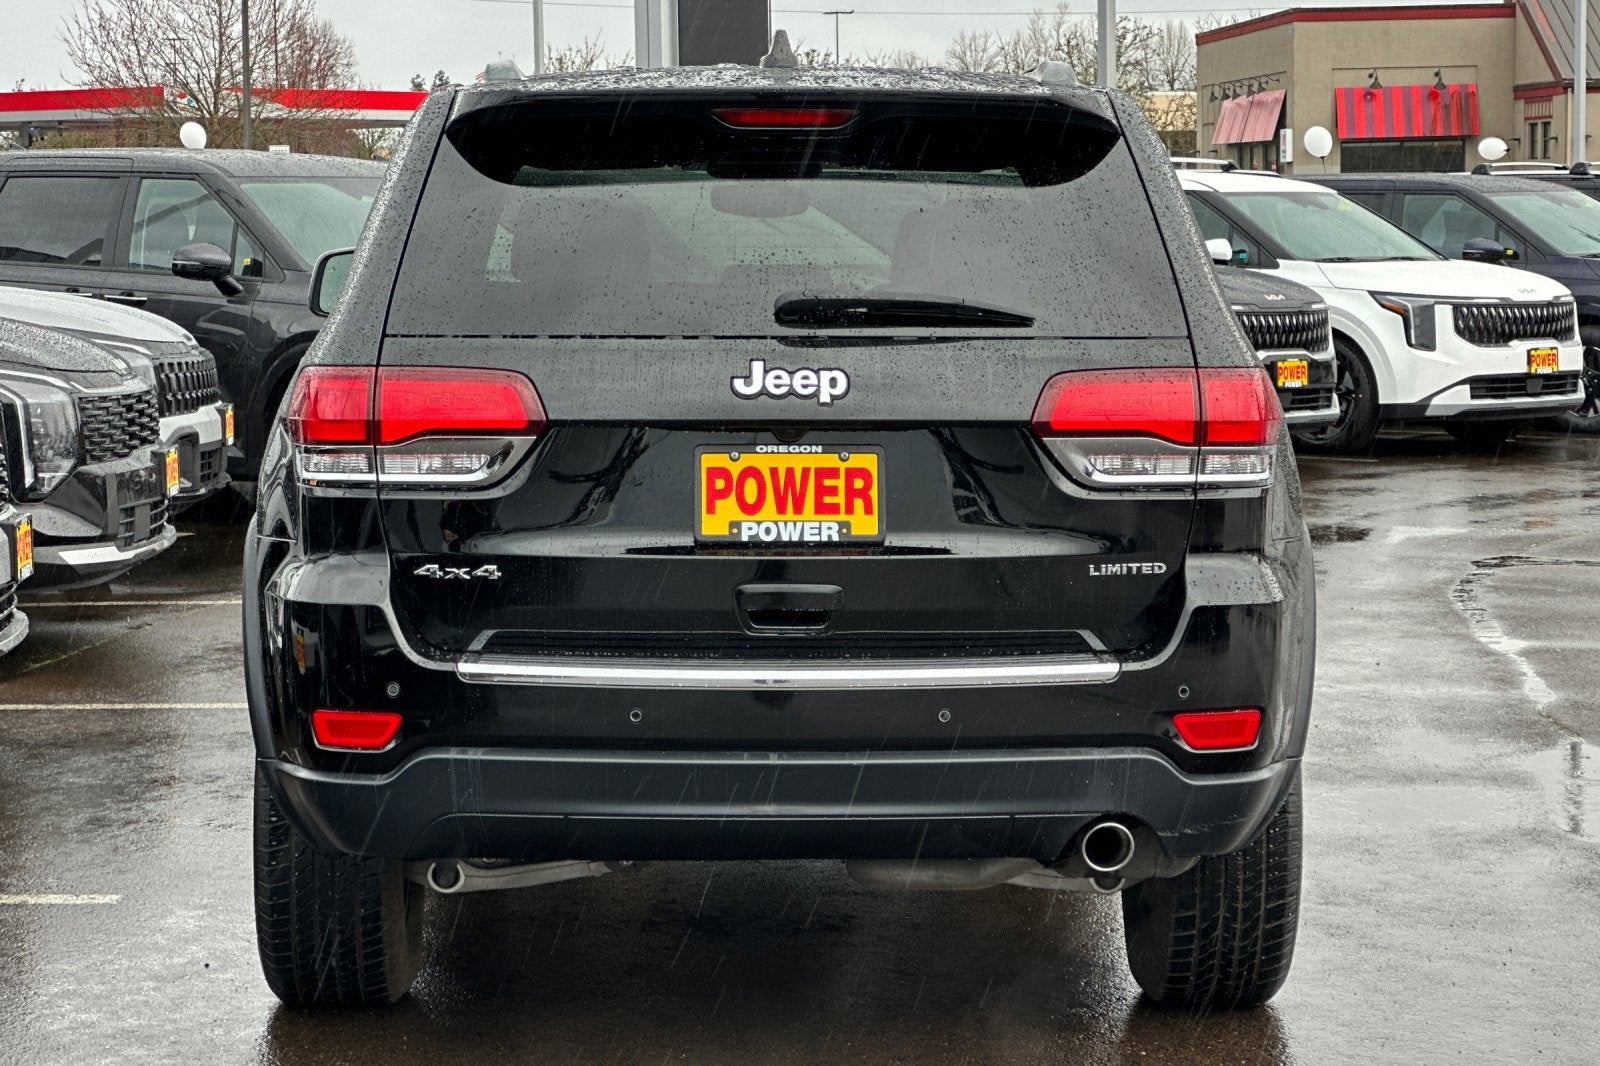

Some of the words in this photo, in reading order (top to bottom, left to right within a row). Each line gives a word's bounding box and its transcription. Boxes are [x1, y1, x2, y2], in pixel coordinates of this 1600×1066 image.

[1531, 353, 1557, 367] POWER
[1278, 366, 1306, 381] POWER
[732, 359, 849, 406] Jeep
[755, 445, 823, 453] OREGON
[705, 466, 874, 516] POWER
[741, 521, 839, 542] POWER
[413, 564, 502, 580] 4x4
[1088, 562, 1167, 576] LIMITED
